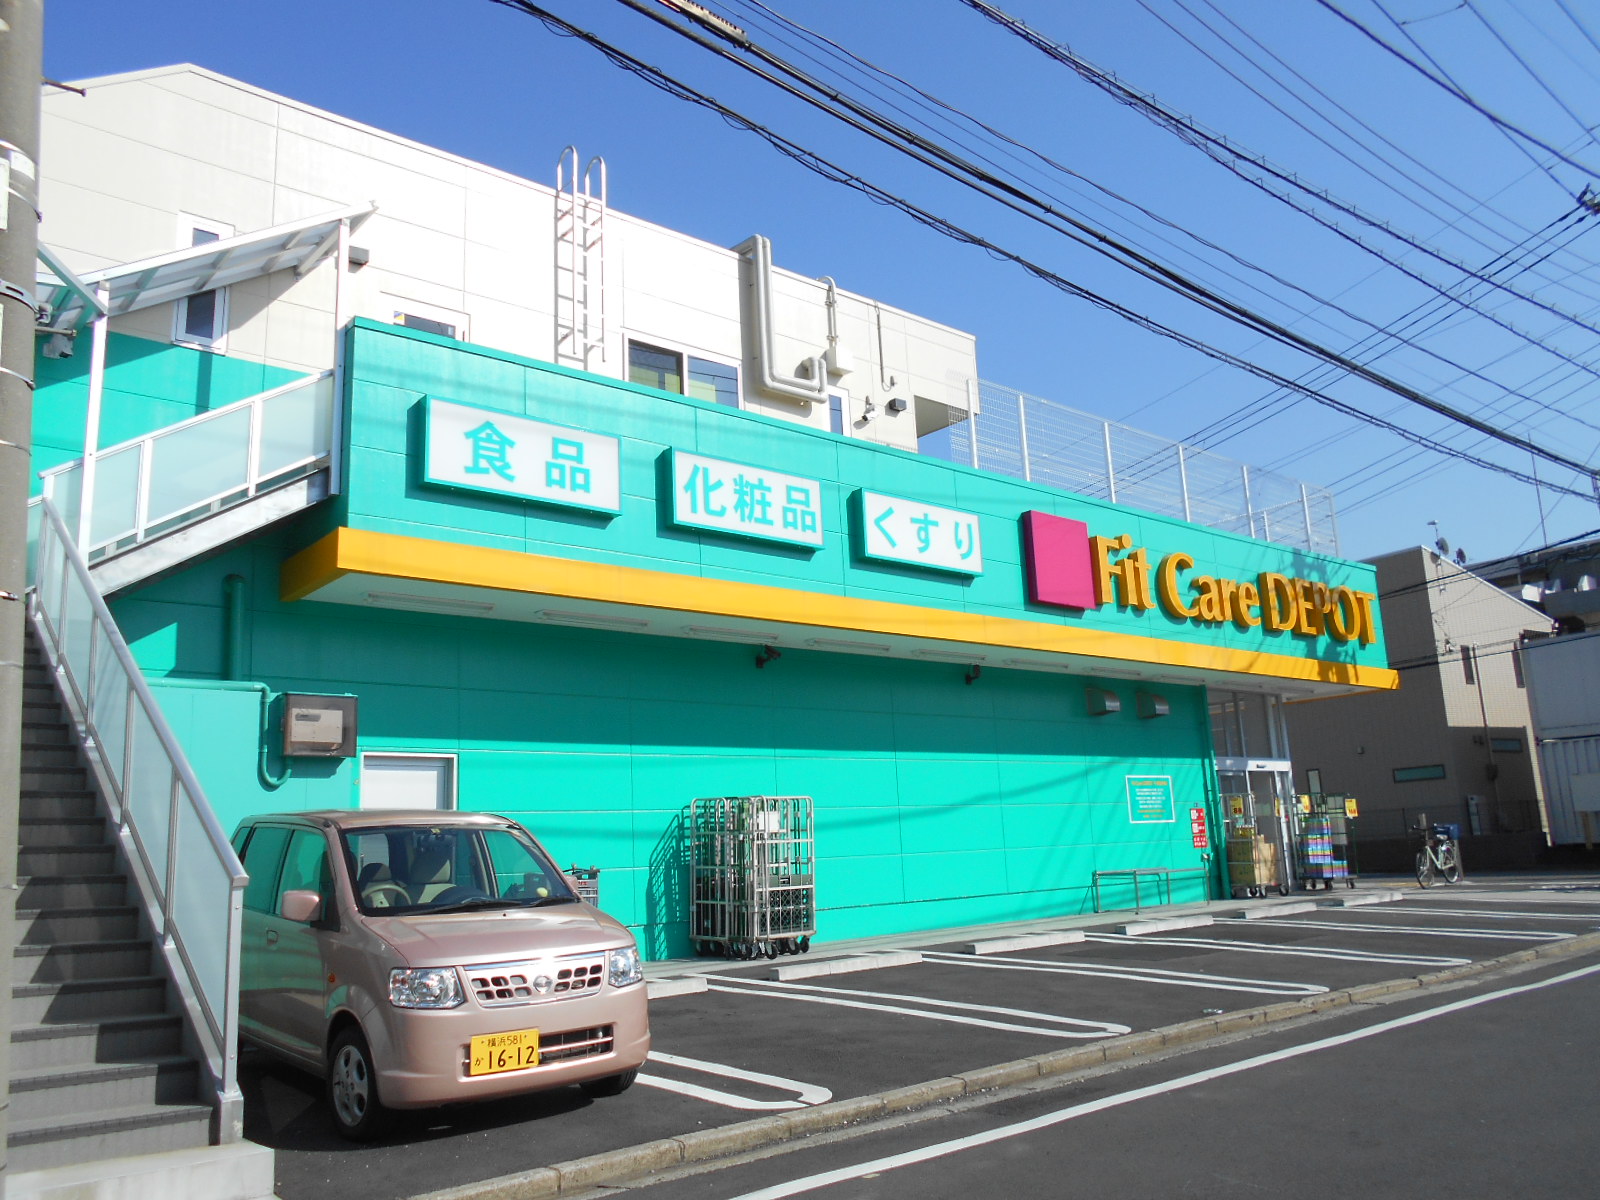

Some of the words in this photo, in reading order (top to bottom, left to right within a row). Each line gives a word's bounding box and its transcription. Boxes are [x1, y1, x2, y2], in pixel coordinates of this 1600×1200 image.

[464, 420, 592, 494] 食品
[683, 463, 818, 534] 化粧品
[872, 505, 975, 562] くすり
[1090, 533, 1156, 610] Fit
[1156, 552, 1262, 627] Care
[1259, 571, 1376, 645] DEPOT
[488, 1045, 535, 1070] 16-12
